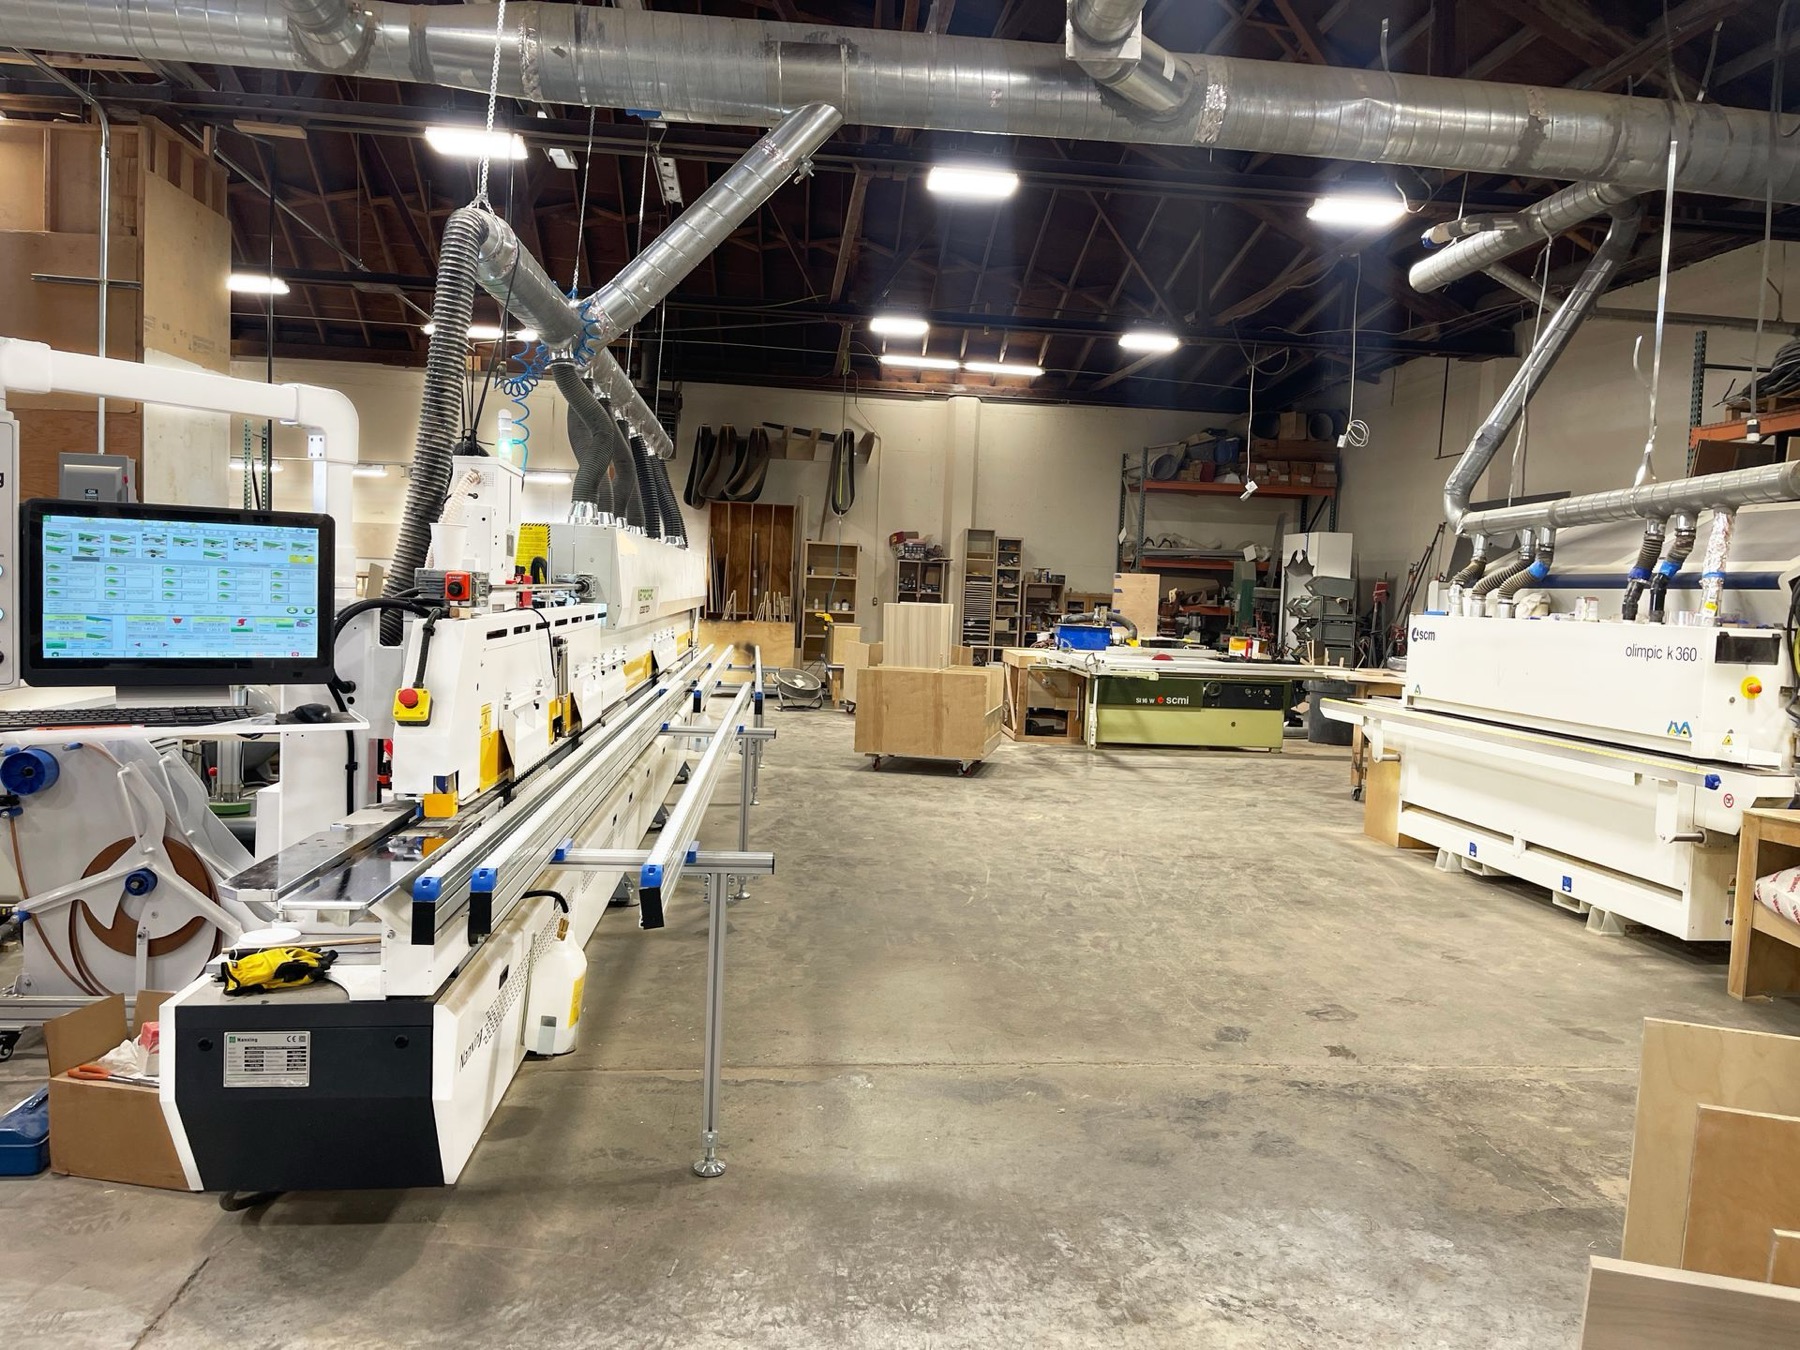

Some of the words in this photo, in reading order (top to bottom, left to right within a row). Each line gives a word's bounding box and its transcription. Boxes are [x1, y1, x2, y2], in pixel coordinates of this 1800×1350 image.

[1419, 630, 1436, 641] scm
[1625, 643, 1663, 662] olimpic
[1166, 696, 1190, 705] scmi
